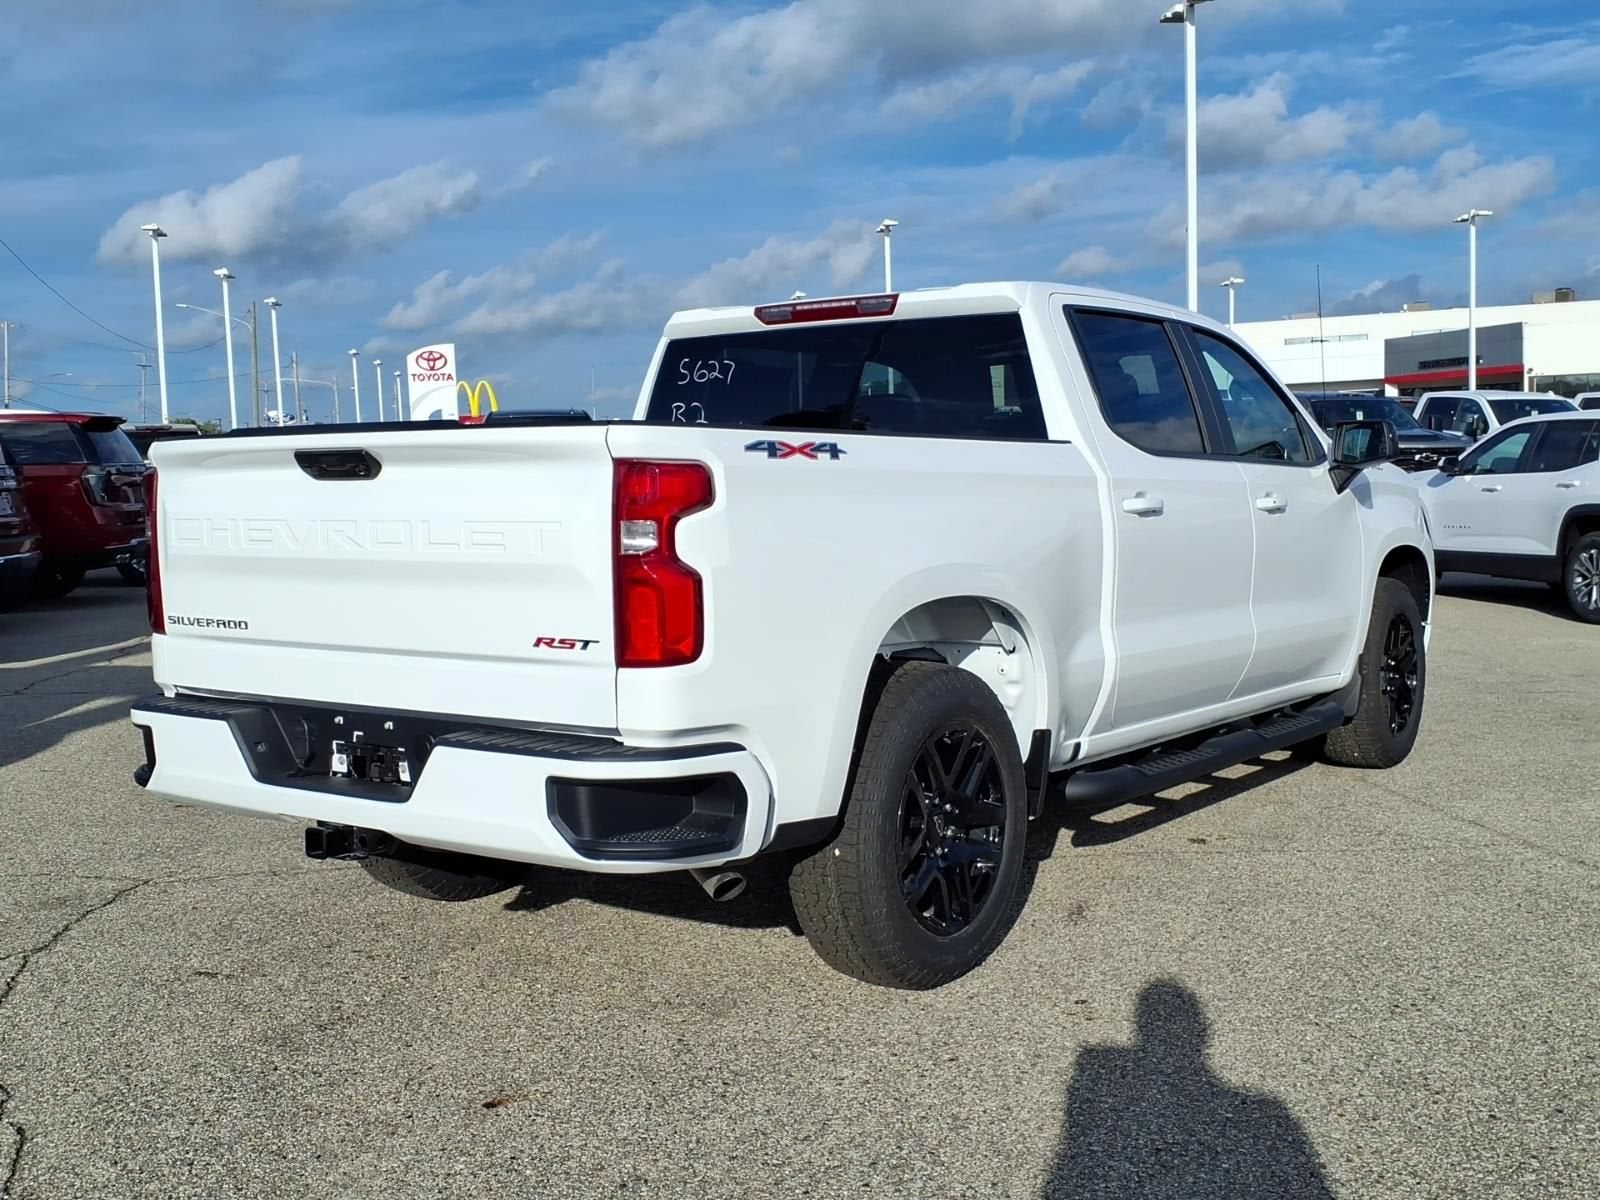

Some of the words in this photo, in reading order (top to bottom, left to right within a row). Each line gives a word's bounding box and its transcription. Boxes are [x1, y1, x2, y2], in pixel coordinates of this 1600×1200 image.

[411, 373, 454, 382] TOYOTA
[171, 517, 564, 555] CHEVROLET
[168, 615, 249, 630] SILVERADO
[533, 637, 600, 650] RST
